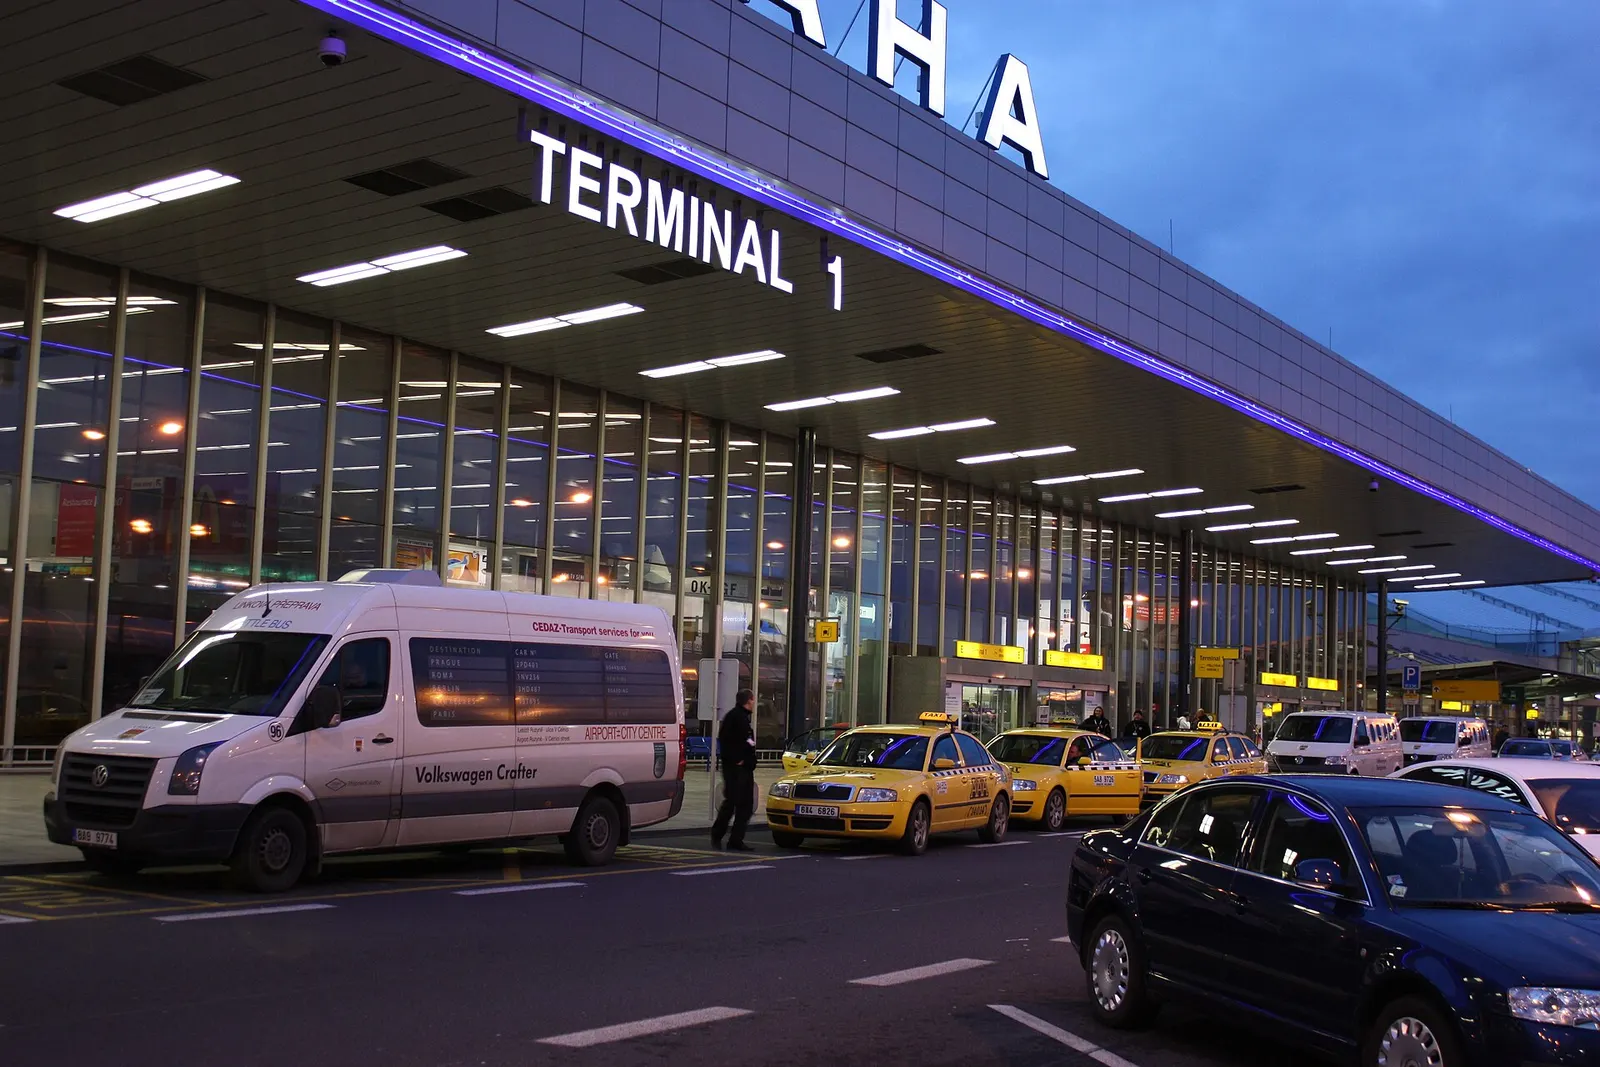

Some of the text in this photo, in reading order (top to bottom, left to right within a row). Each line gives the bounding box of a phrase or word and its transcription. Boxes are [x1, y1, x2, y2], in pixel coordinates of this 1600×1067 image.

[530, 129, 842, 312] TERMINAL 1
[267, 620, 293, 630] BUS
[532, 621, 598, 636] CEDAZ-Transport
[598, 627, 629, 637] services
[629, 628, 640, 638] for
[429, 645, 481, 655] DESTINATION
[514, 648, 528, 656] CAR
[604, 652, 619, 660] GATE
[430, 658, 461, 667] PRAGUE
[431, 671, 454, 680] ROMA
[1406, 667, 1416, 681] P
[433, 710, 456, 718] PARIS
[270, 724, 282, 738] 96
[584, 727, 617, 741] AIRPORT
[621, 726, 639, 740] CITY
[638, 726, 667, 740] CENTRE
[415, 763, 538, 786] Volkswagen Crafter
[817, 806, 835, 815] 6826
